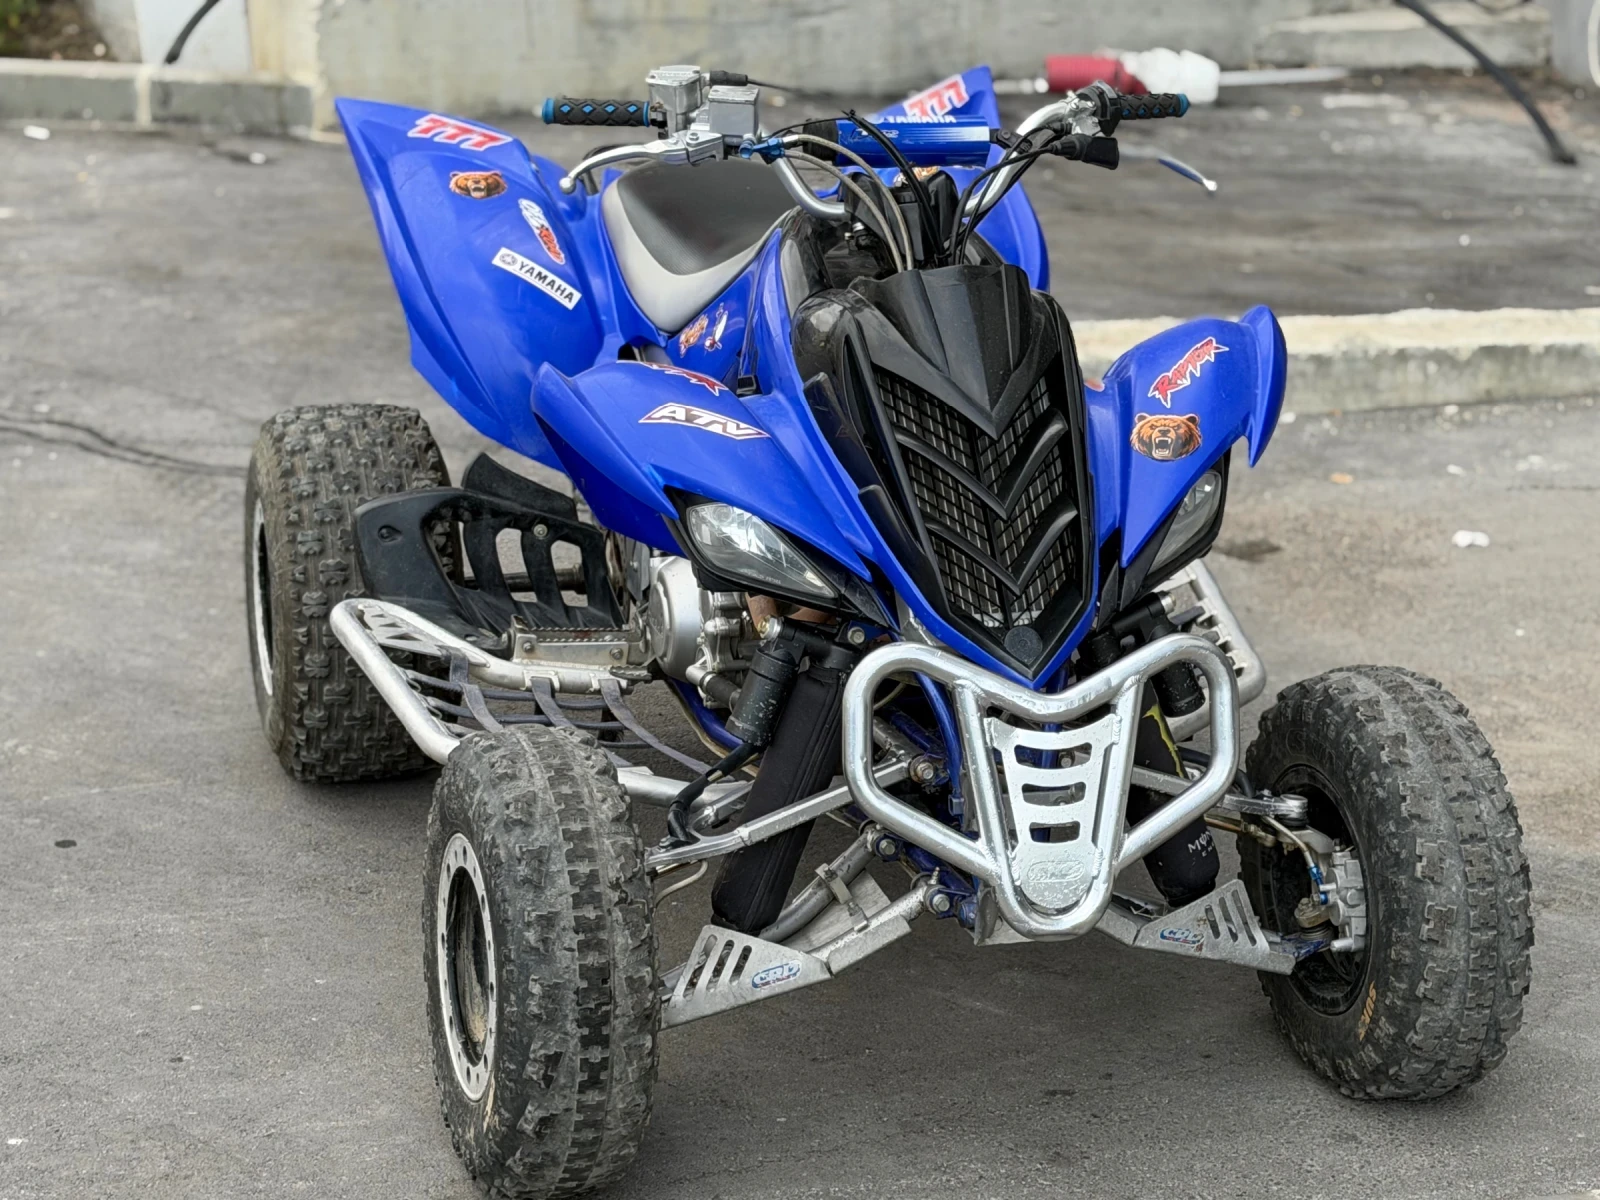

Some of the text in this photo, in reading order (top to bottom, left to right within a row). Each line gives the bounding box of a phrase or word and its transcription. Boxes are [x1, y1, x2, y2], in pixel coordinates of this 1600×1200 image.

[408, 114, 512, 151] 777
[518, 260, 575, 304] YAMAHA
[645, 404, 766, 438] ATV
